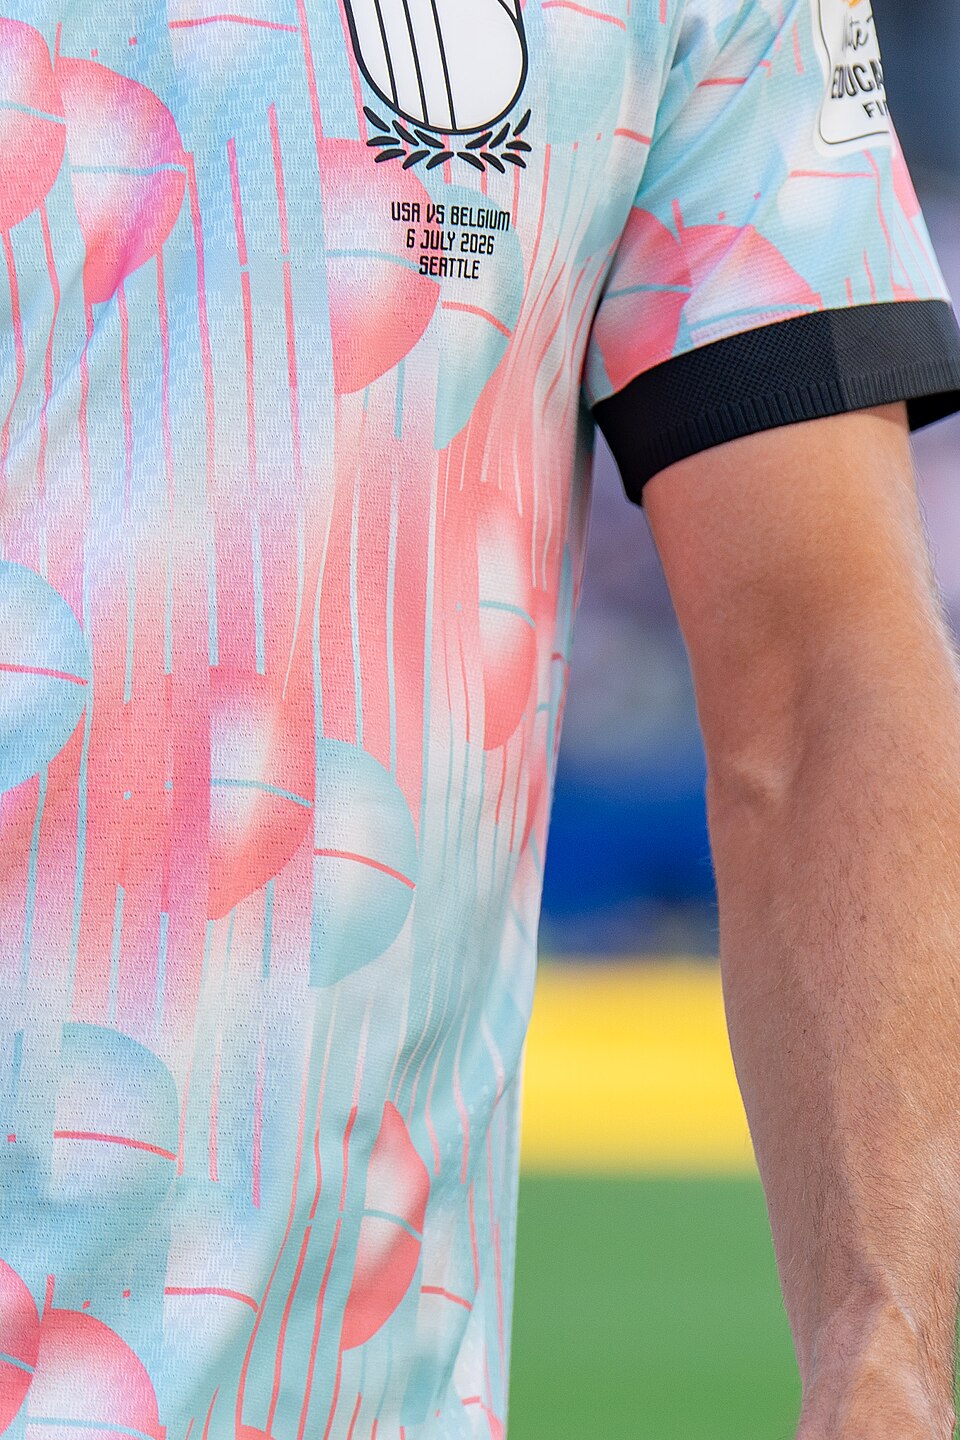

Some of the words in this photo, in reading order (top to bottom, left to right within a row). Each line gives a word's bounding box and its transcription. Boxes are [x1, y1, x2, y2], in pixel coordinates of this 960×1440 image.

[391, 201, 420, 222] USA
[426, 203, 445, 224] VS
[450, 205, 511, 231] BELGIUM
[406, 228, 416, 248] 6
[420, 229, 456, 251] JULY
[460, 233, 495, 255] 2026
[419, 255, 481, 279] SEATTLE
